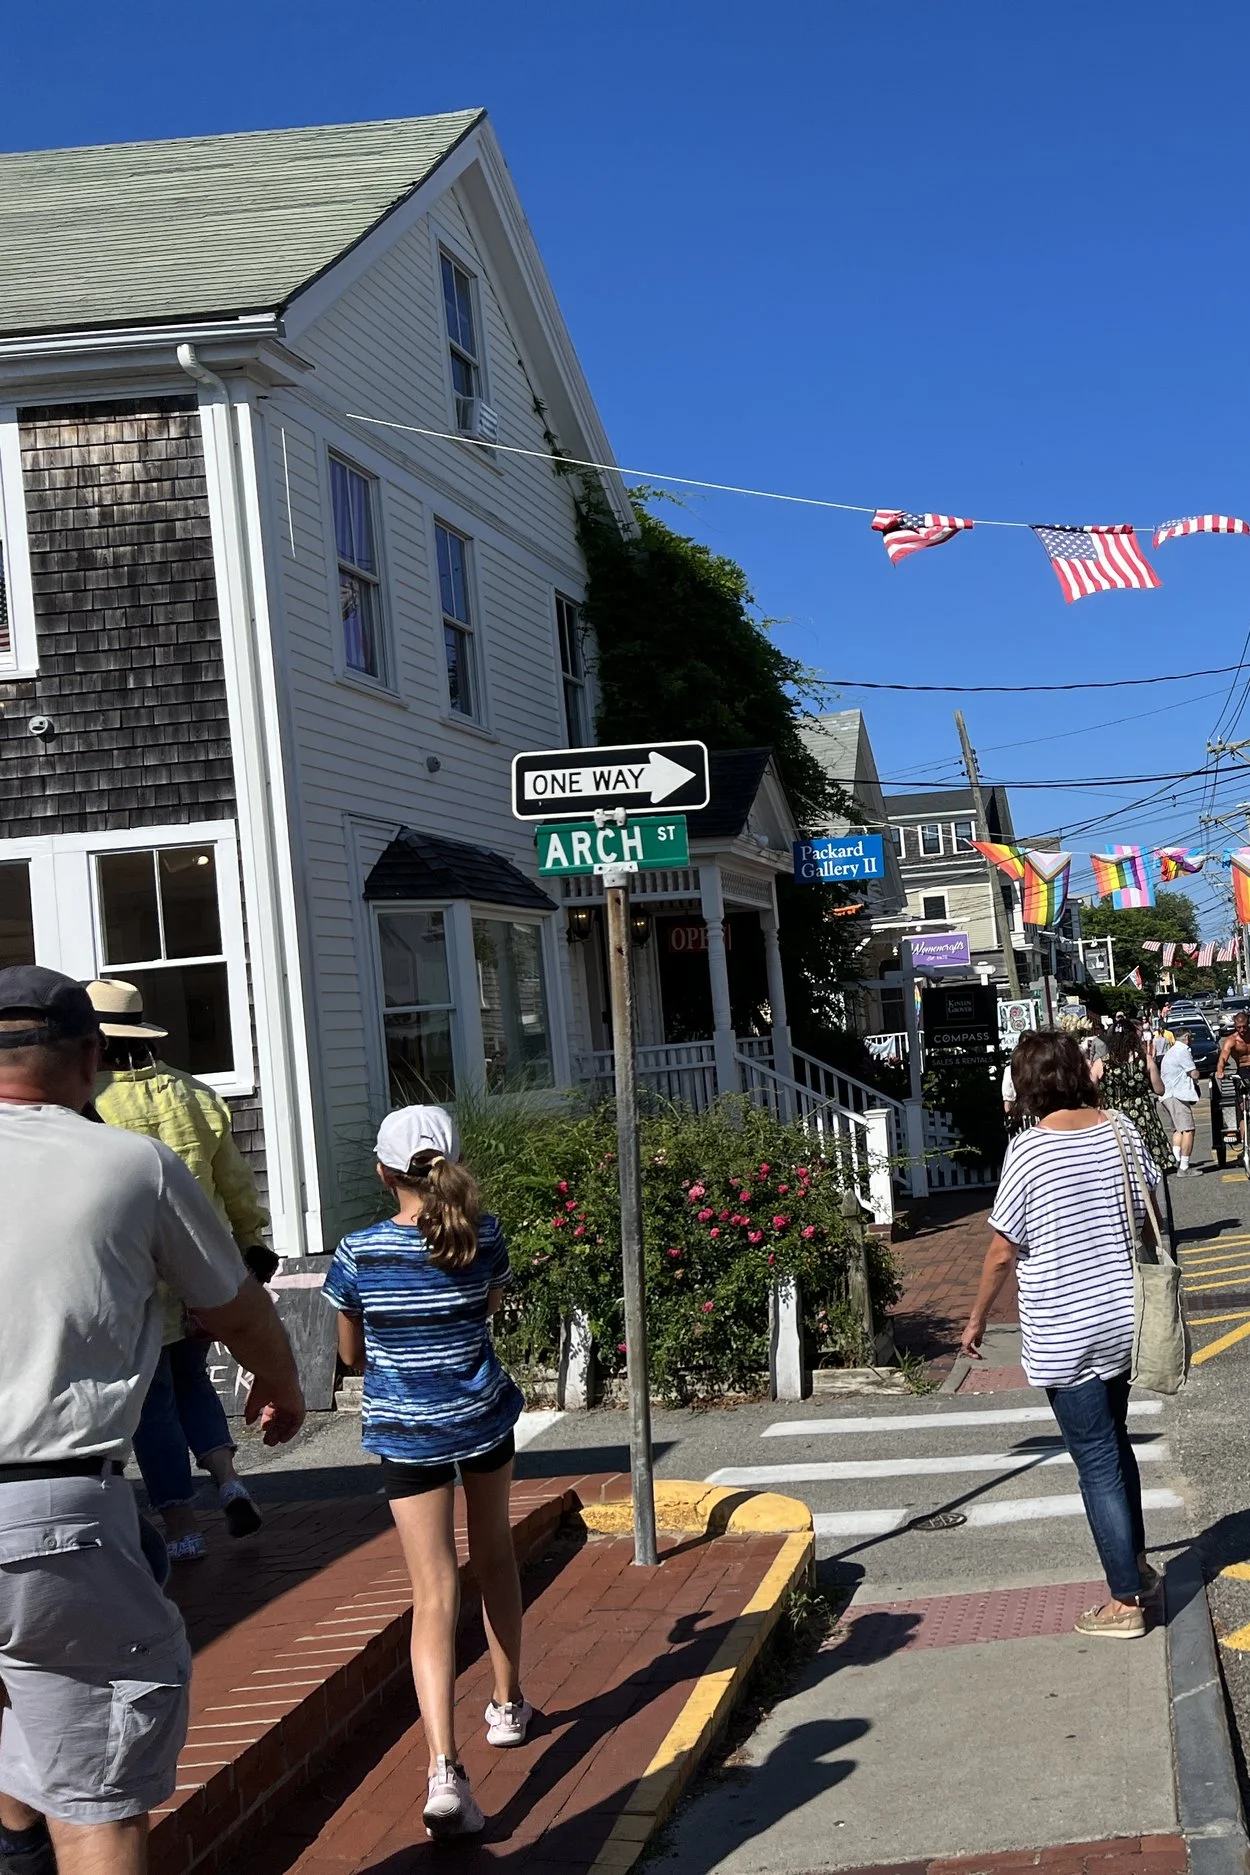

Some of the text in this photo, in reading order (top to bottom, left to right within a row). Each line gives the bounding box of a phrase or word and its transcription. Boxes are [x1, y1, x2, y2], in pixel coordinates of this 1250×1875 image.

[533, 768, 645, 795] ONE WAY
[545, 826, 676, 868] ARCH ST
[801, 841, 864, 860] Packard
[801, 857, 878, 878] Gallery II
[671, 924, 731, 951] OPE
[934, 1032, 990, 1043] COMPASS
[932, 1058, 954, 1066] SALES
[962, 1056, 994, 1065] RENTALS
